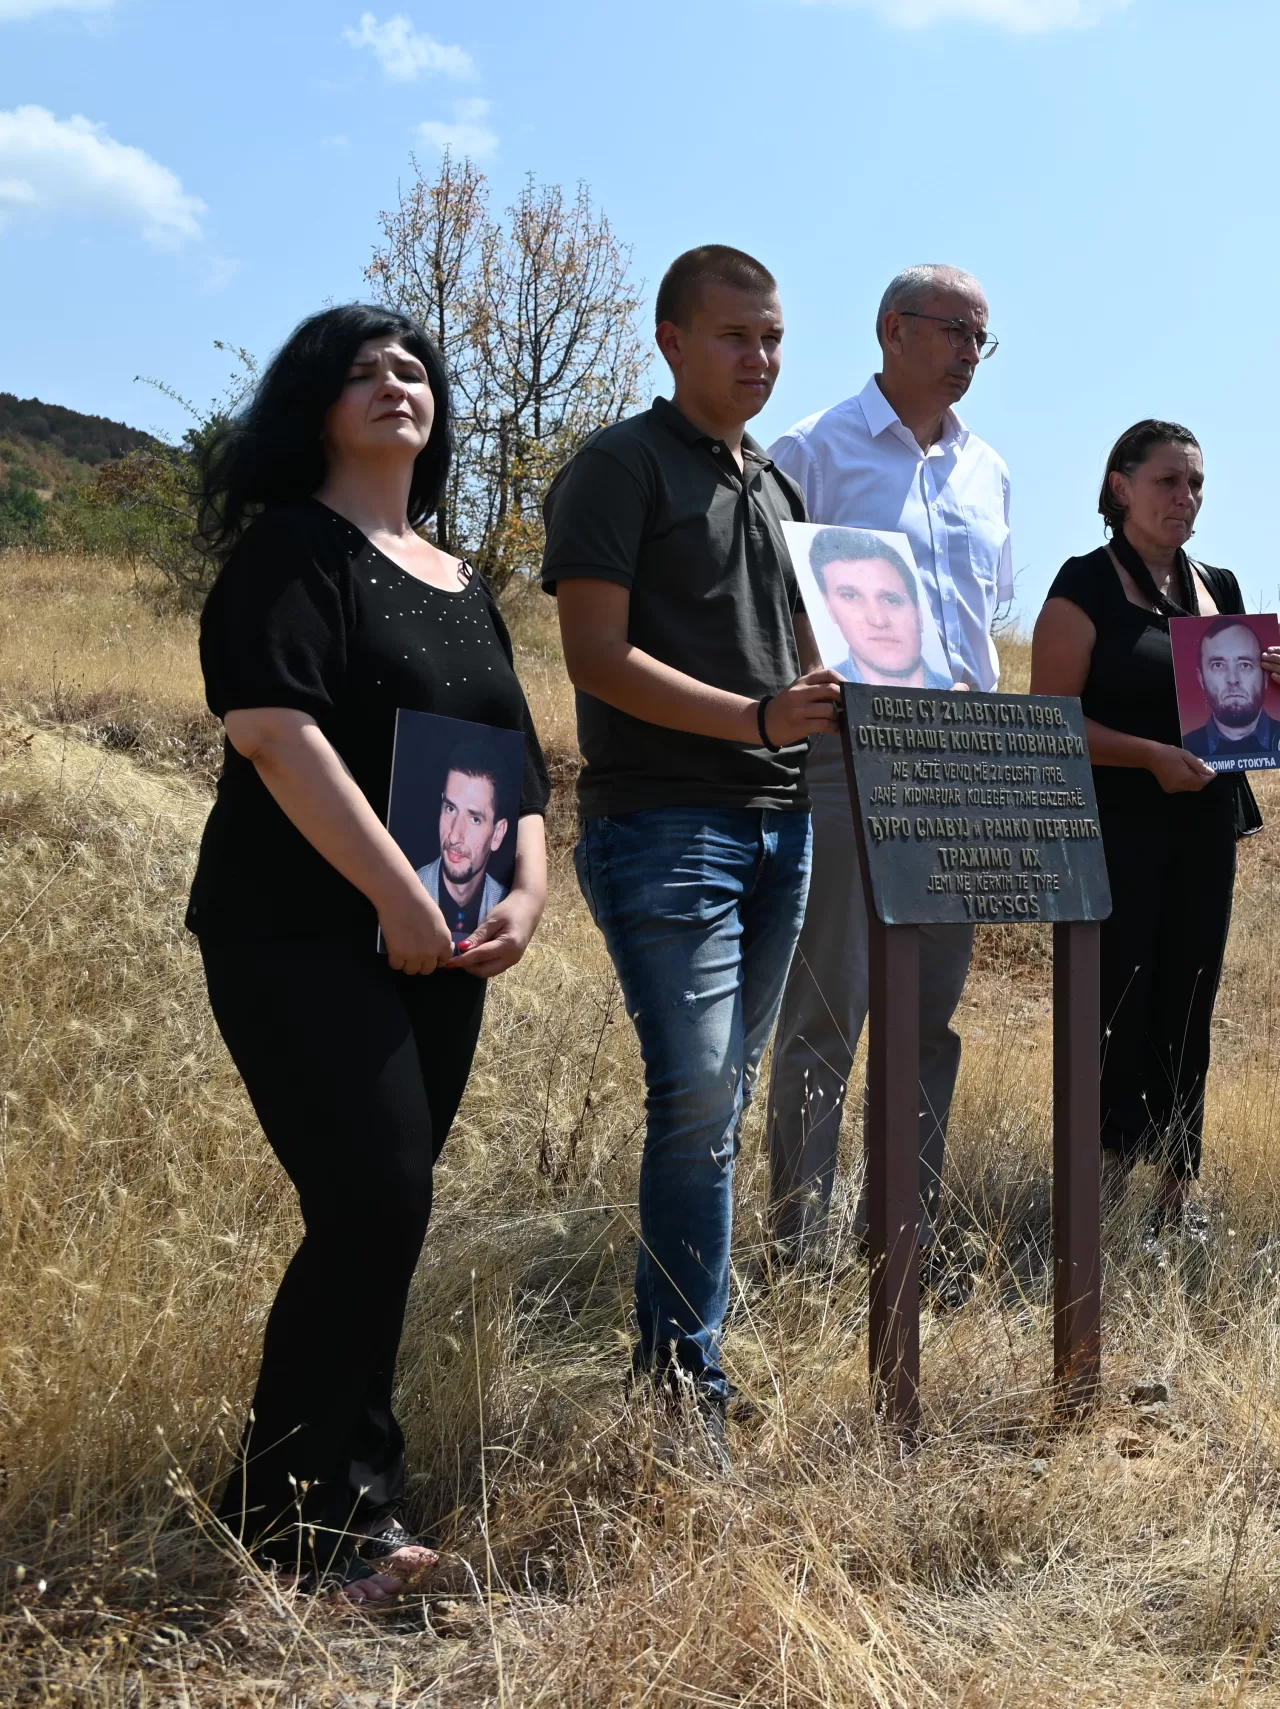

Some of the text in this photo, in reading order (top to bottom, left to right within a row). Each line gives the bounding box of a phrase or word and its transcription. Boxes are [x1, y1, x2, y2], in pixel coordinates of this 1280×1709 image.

[873, 697, 914, 718] ОВДЕ
[919, 700, 936, 719] СУ
[1028, 705, 1067, 725] 1998.
[859, 726, 1084, 755] ОТЕТЕ НАШЕ КОЛЕГЕ НОВИНАРИ
[1237, 757, 1277, 769] СТОКУЋА
[870, 784, 897, 803] JANË
[904, 787, 962, 805] KIDNAPUAR
[868, 817, 911, 840] ЂУРО
[916, 817, 970, 837] СЛАВУЈ
[984, 818, 1031, 837] РАНКО
[1034, 819, 1099, 838] ПЕРЕНИЋ
[938, 847, 1042, 868] ТРАЖИМО ИХ
[927, 875, 951, 891] JEMI
[976, 872, 1013, 891] KËRKIM
[1016, 872, 1029, 889] TË
[1032, 874, 1060, 890] TYRE
